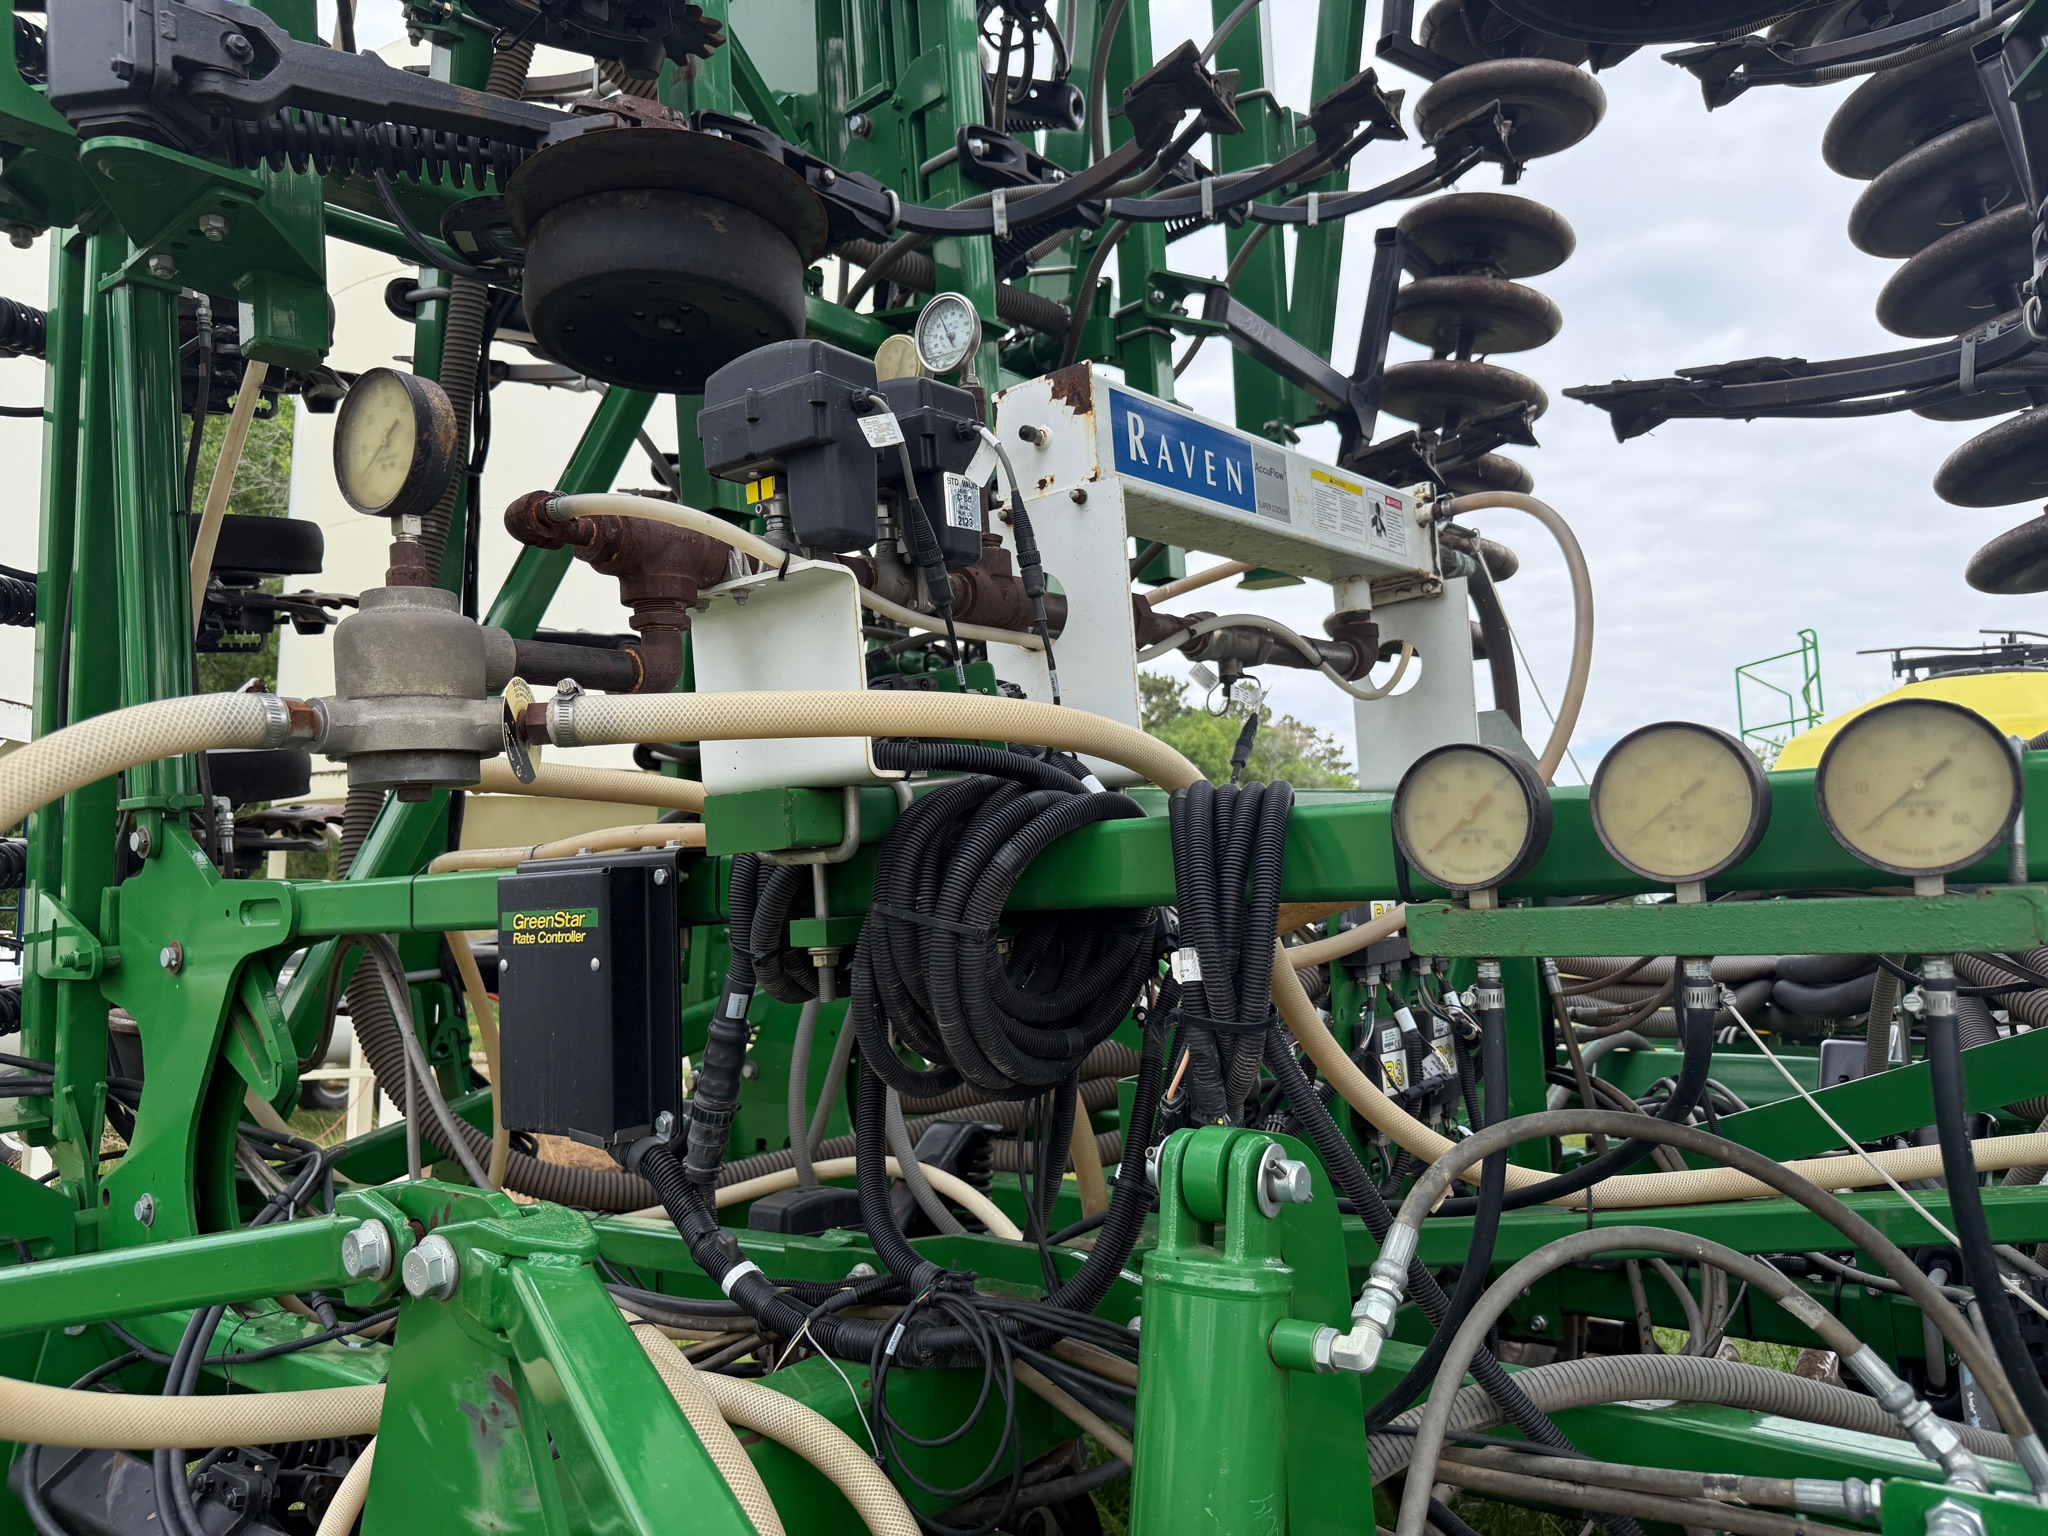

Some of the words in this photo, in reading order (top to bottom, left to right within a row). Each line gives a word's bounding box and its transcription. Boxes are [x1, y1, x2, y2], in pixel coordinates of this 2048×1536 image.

[1127, 411, 1243, 496] RAVEN
[1255, 462, 1284, 480] AccuFlow
[947, 477, 959, 486] STD
[962, 480, 979, 491] VALVE
[1258, 501, 1271, 511] SUPER
[1272, 505, 1288, 516] COOLER
[1952, 813, 1971, 826] 60
[513, 911, 587, 930] GreenStar
[513, 932, 536, 944] Rate
[538, 930, 586, 944] Controller
[1384, 1059, 1405, 1089] B3
